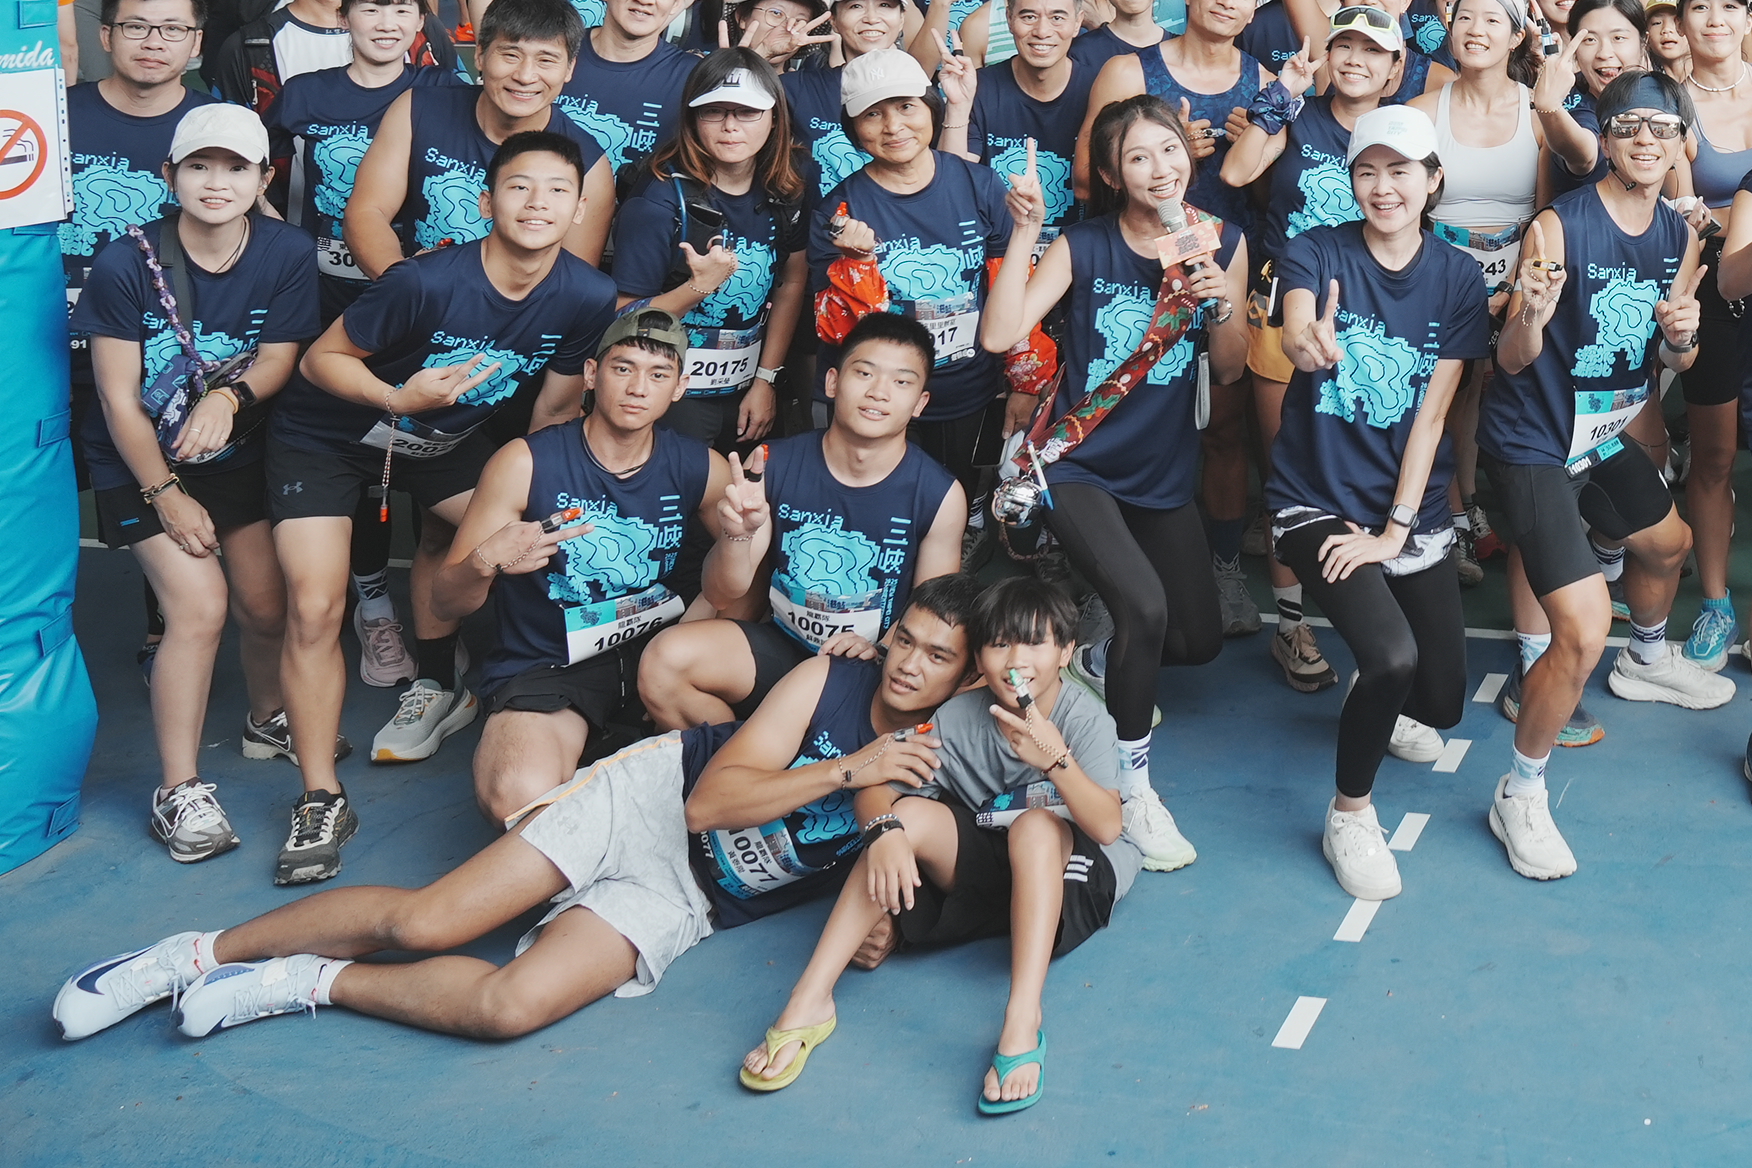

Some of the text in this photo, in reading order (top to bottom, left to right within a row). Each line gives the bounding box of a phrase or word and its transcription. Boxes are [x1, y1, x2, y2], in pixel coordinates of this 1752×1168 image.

[1411, 13, 1439, 23] Sanx
[1271, 49, 1297, 62] San
[552, 94, 599, 111] anxia
[306, 122, 369, 138] Sanxia
[809, 117, 843, 132] San
[70, 150, 131, 170] anxia
[425, 147, 487, 182] Sanxia
[1300, 143, 1349, 167] Sanxi
[873, 234, 919, 253] anxia
[1587, 262, 1637, 281] Sanxia
[1093, 278, 1151, 298] Sanxia
[70, 339, 87, 349] 91
[691, 357, 750, 378] 20175
[1589, 415, 1628, 441] 10301
[778, 503, 845, 528] Sanxia
[594, 616, 662, 651] 10076
[813, 730, 846, 759] San
